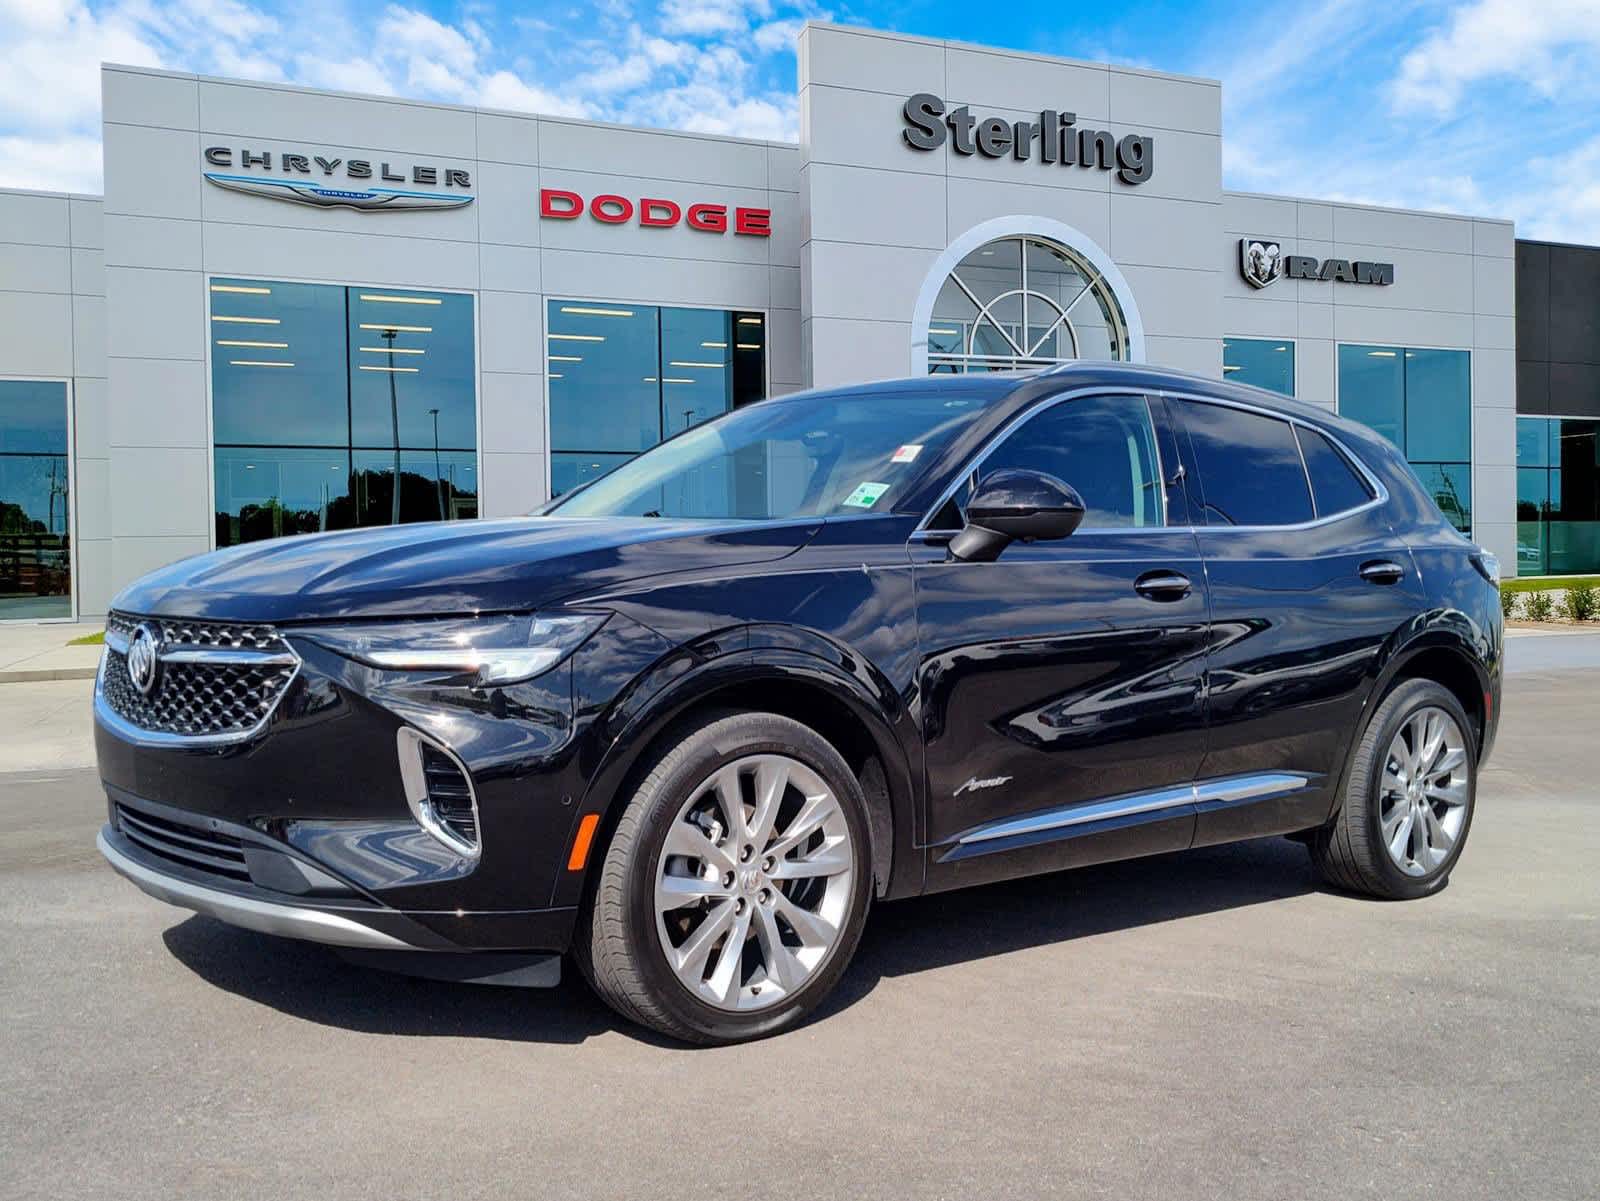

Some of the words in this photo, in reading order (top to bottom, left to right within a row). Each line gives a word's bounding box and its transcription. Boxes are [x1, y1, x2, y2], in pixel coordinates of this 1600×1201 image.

[903, 93, 1154, 184] Sterling
[204, 146, 472, 188] CHRYSLER
[540, 188, 771, 237] DODGE
[1286, 255, 1394, 286] RAM
